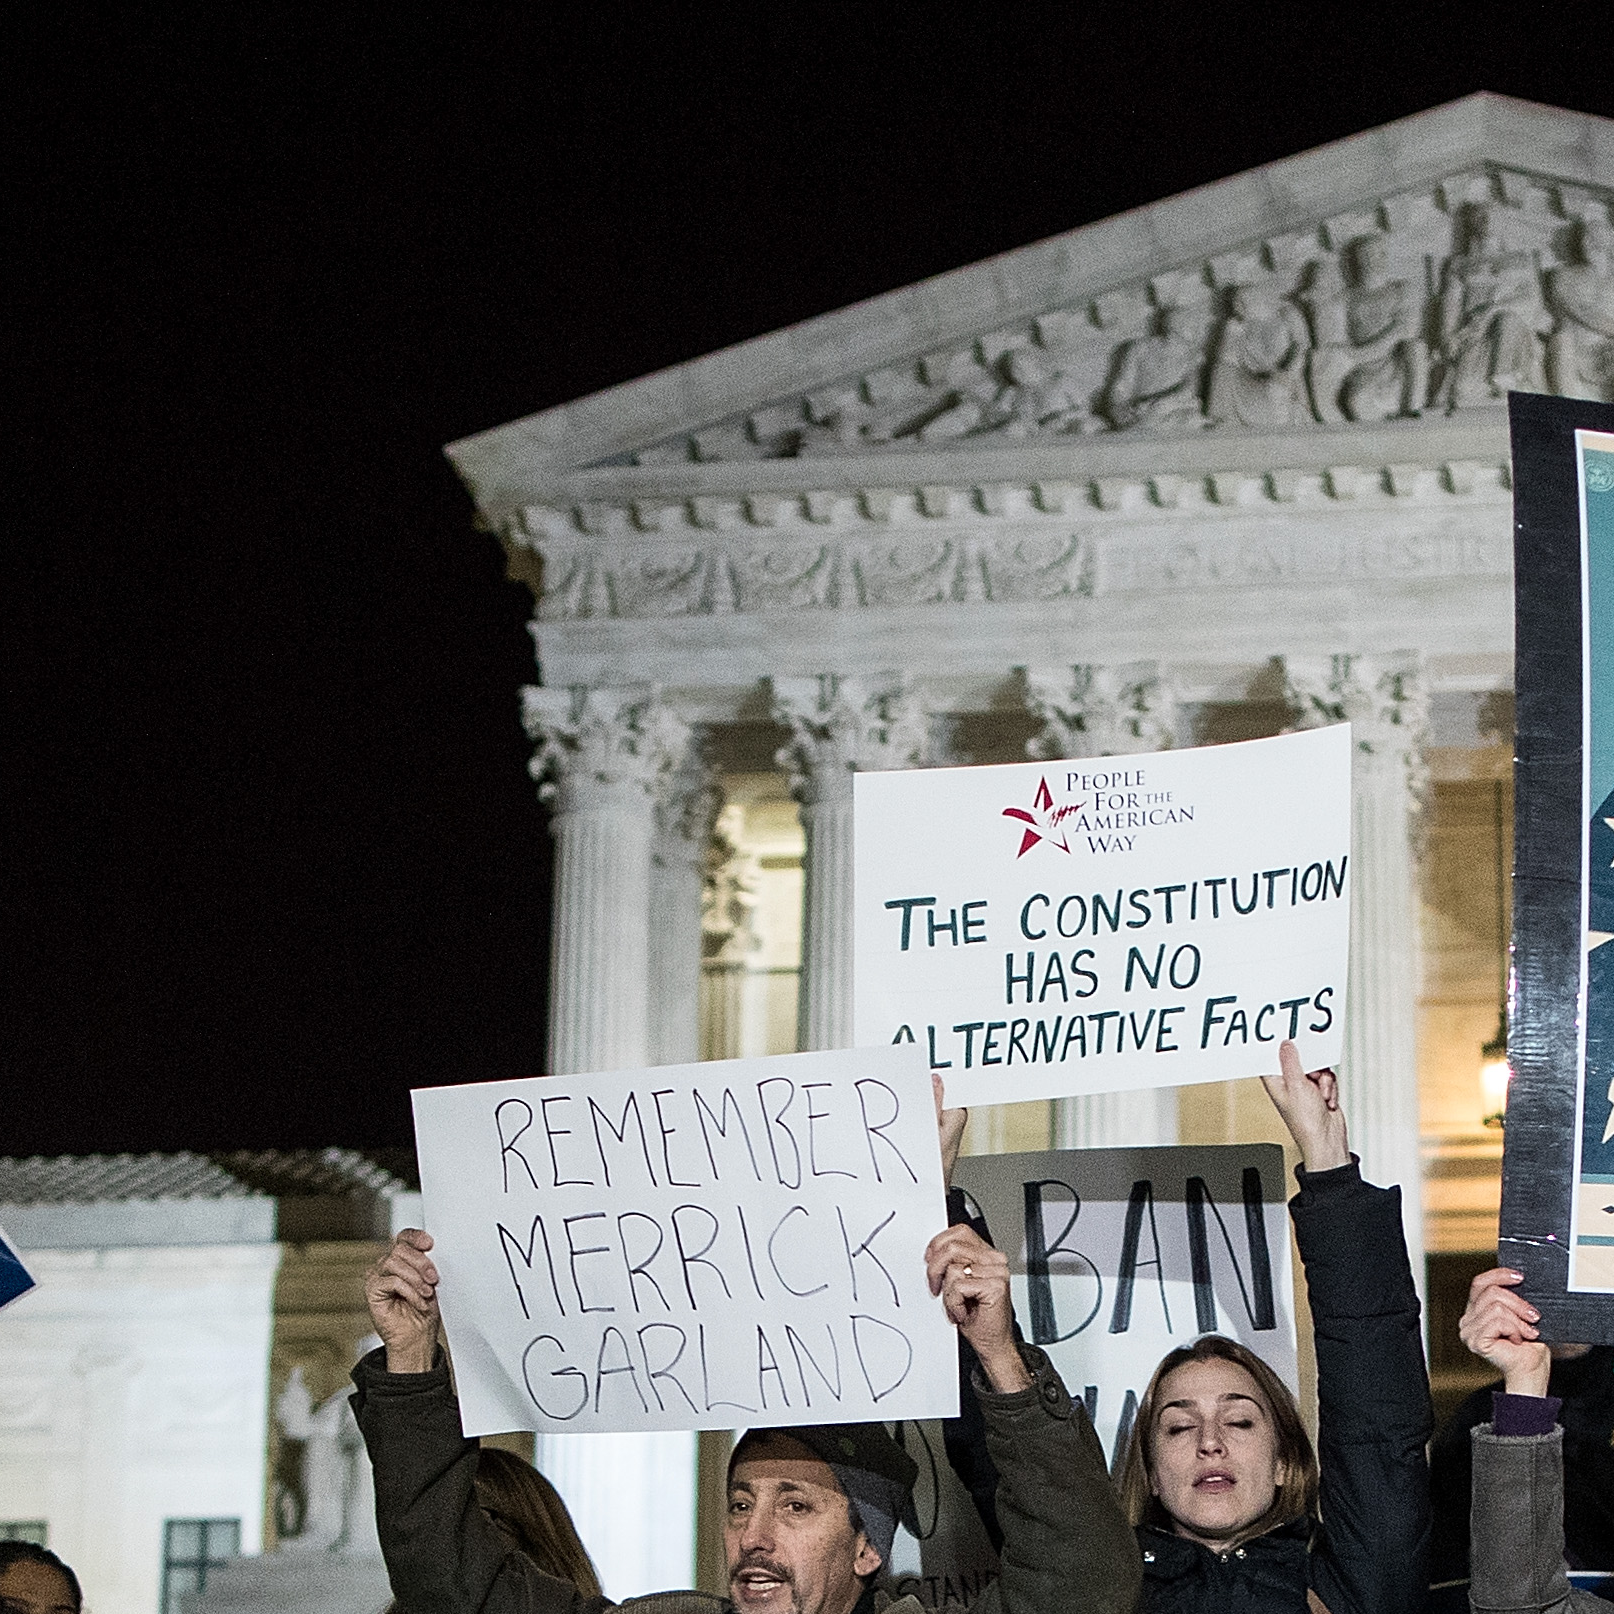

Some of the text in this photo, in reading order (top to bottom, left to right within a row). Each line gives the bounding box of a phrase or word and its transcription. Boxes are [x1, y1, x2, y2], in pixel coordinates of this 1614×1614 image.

[1067, 770, 1146, 792] PEOPLE
[1095, 792, 1173, 811] FOR THE
[1075, 806, 1195, 832] AMERICAN
[1087, 834, 1137, 854] WAY
[885, 854, 1348, 951] THE CONSTITUTION
[1005, 943, 1202, 1004] HAS NO
[1200, 987, 1334, 1050] FACTS
[495, 1076, 919, 1194] REMEMBER
[497, 1205, 900, 1320] MERRICK
[1023, 1166, 1277, 1346] BAN
[522, 1314, 912, 1420] GARLAND
